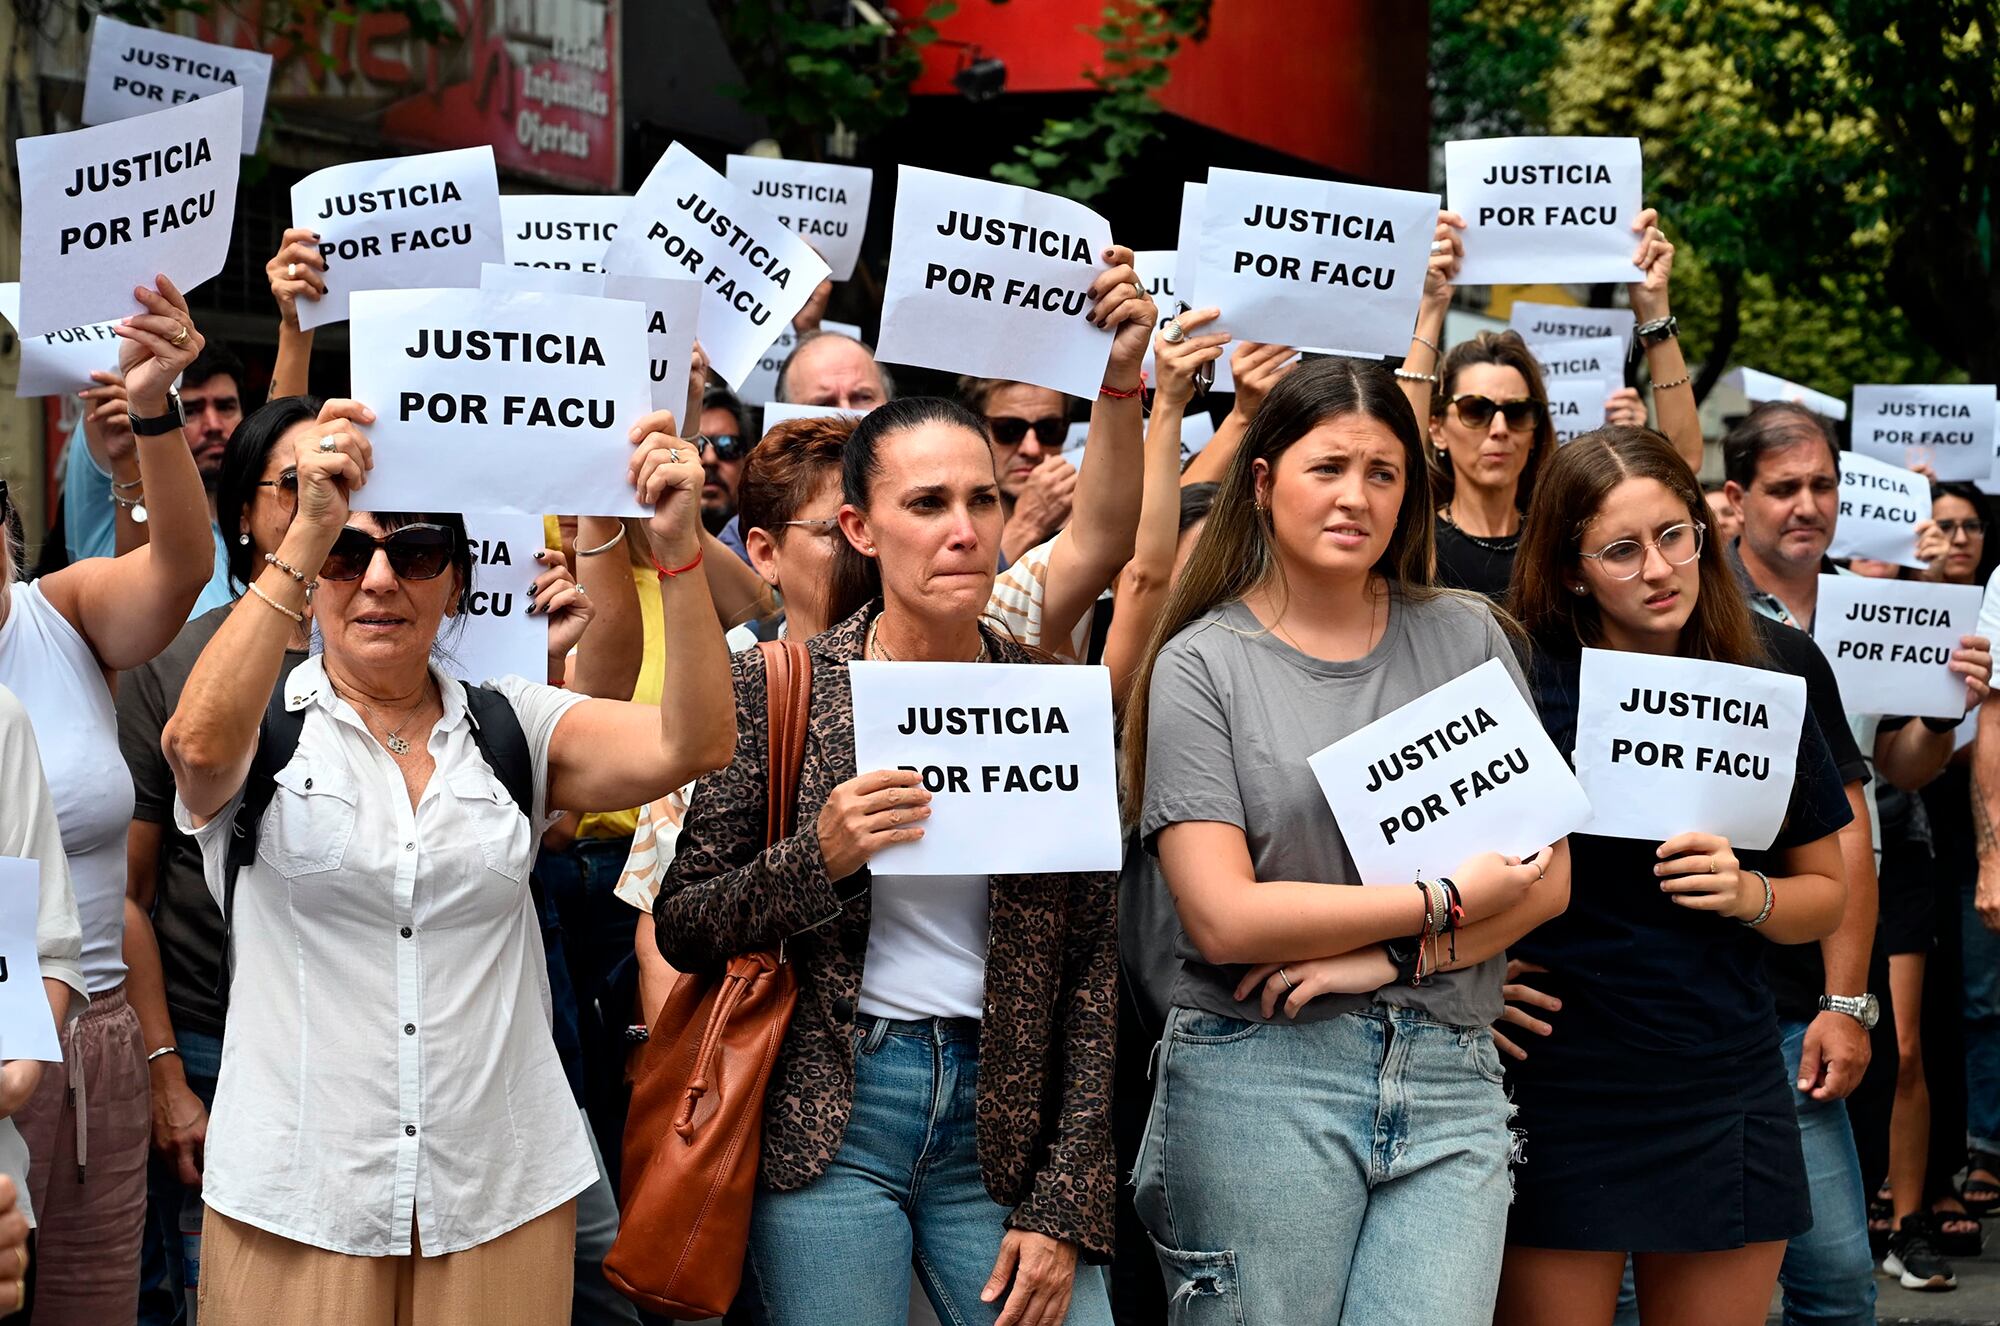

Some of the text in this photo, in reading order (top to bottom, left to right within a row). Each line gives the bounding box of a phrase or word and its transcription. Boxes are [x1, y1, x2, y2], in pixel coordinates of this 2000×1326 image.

[121, 47, 237, 86] JUSTICIA
[113, 76, 164, 102] POR
[65, 137, 212, 197] JUSTICIA
[1483, 164, 1611, 185] JUSTICIA
[318, 181, 462, 219] JUSTICIA
[752, 180, 847, 205] JUSTICIA
[60, 189, 216, 255] POR FACU
[517, 221, 618, 241] JUSTIC
[798, 217, 848, 237] FACU
[1244, 204, 1395, 244] JUSTICIA
[1479, 206, 1617, 226] POR FACU
[318, 223, 472, 261] POR FACU
[676, 193, 791, 290] JUSTICIA
[937, 210, 1093, 265] JUSTICIA
[647, 221, 704, 274] POR
[704, 265, 772, 326] FACU
[925, 262, 1087, 316] POR FACU
[1233, 250, 1395, 291] POR FACU
[405, 329, 606, 367] JUSTICIA
[1532, 321, 1613, 338] JUSTICIA
[400, 391, 615, 429] POR FACU
[1877, 402, 1970, 418] JUSTICIA
[1873, 429, 1974, 445] POR FACU
[1845, 471, 1909, 496] STICIA
[1861, 504, 1916, 524] FACU
[1846, 603, 1951, 627] JUSTICIA
[1837, 640, 1950, 665] POR FACU
[898, 706, 1069, 735] JUSTICIA
[1620, 687, 1769, 729] JUSTICIA
[1365, 707, 1498, 793] JUSTICIA
[1611, 738, 1770, 781] POR FACU
[897, 764, 1079, 793] OR FACU
[1379, 747, 1530, 846] POR FACU
